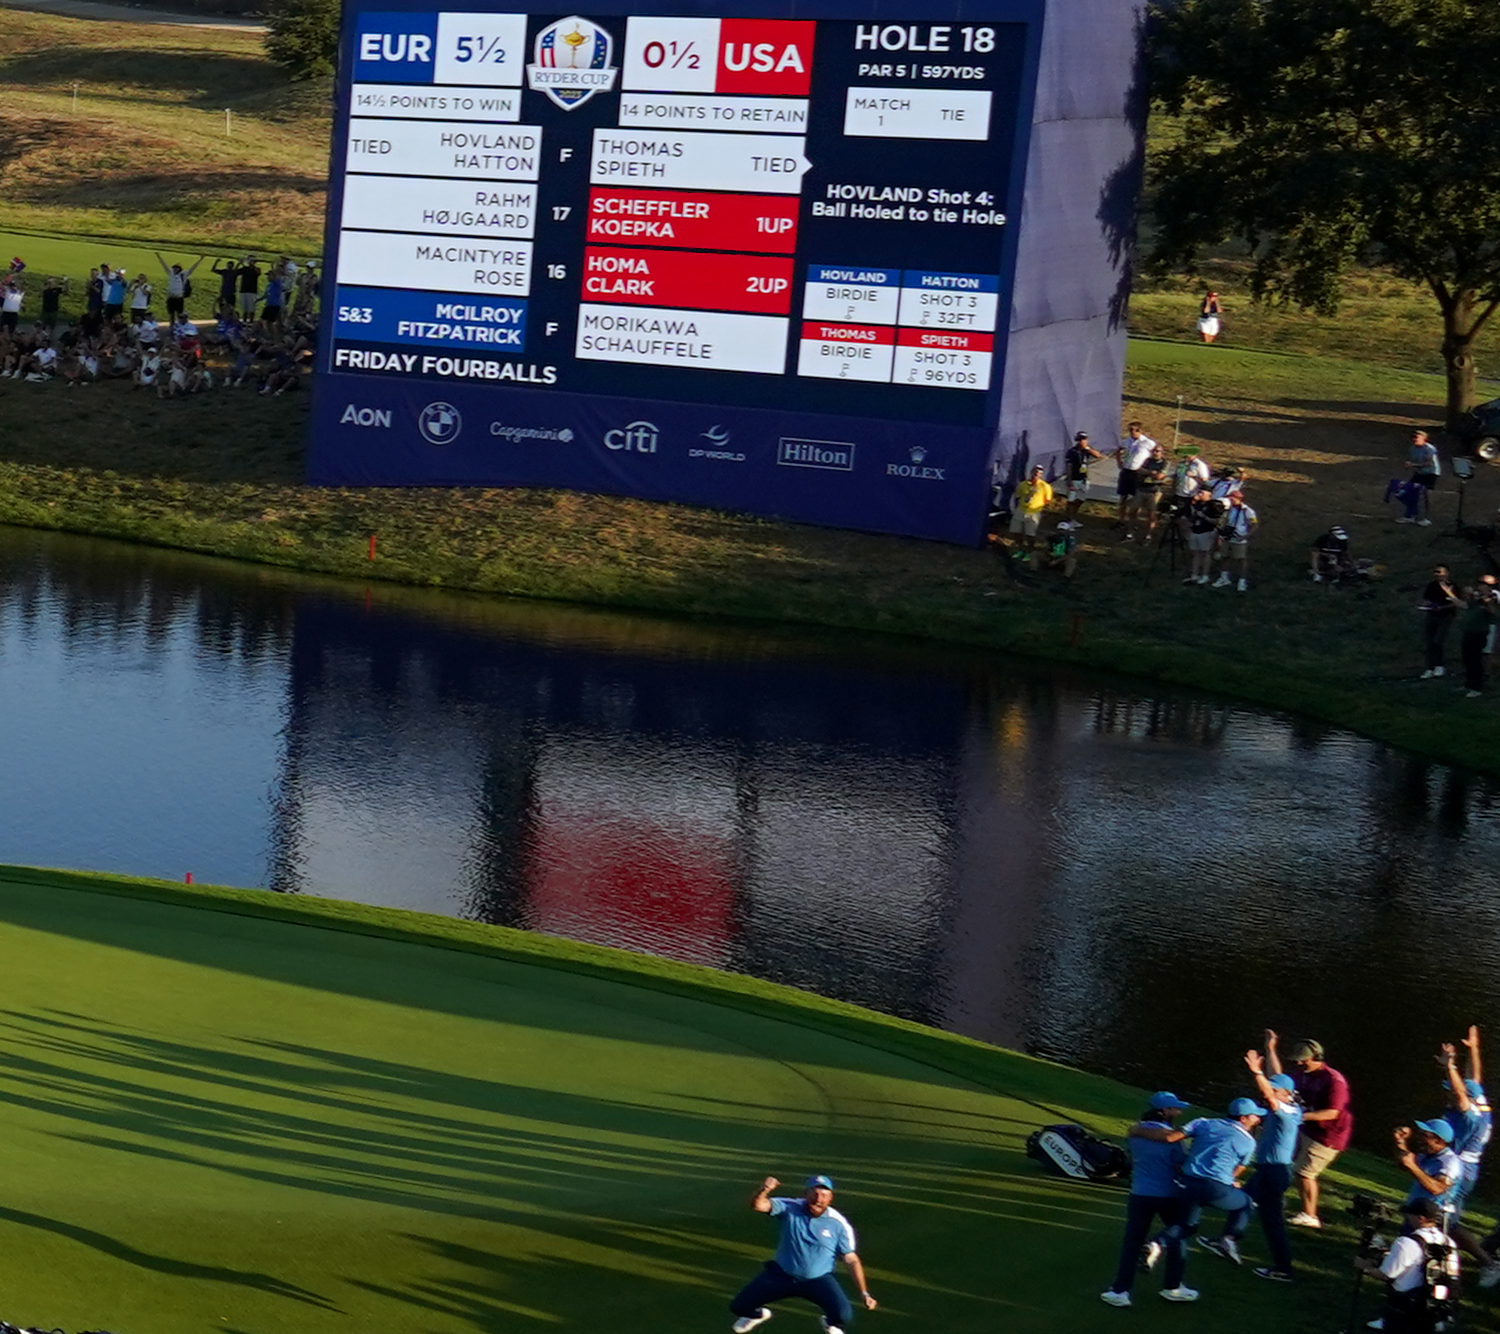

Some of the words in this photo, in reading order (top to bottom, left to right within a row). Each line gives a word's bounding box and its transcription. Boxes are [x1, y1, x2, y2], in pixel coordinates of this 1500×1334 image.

[855, 25, 951, 51] HOLE
[961, 27, 995, 53] 18
[360, 33, 431, 62] EUR
[724, 43, 805, 73] USA
[535, 72, 579, 83] RYDER
[581, 73, 609, 84] CUP
[858, 64, 892, 77] PAR
[896, 65, 906, 77] 5
[922, 66, 985, 79] 597YDS
[390, 95, 446, 109] POINTS
[453, 98, 473, 110] TO
[479, 99, 511, 111] WIN
[854, 98, 910, 110] MATCH
[622, 104, 638, 116] 14
[645, 105, 705, 118] POINTS
[713, 107, 735, 120] TO
[741, 108, 804, 122] RETAIN
[878, 116, 883, 126] 1
[941, 109, 965, 121] TIE
[352, 139, 392, 154] TIED
[441, 133, 535, 150] HOVLAND
[600, 139, 683, 157] THOMAS
[454, 154, 533, 170] HATTON
[560, 148, 573, 162] F
[597, 161, 665, 177] SPIETH
[751, 156, 796, 172] TIED
[475, 192, 531, 208] RAHM
[827, 184, 922, 202] HOVLAND
[927, 189, 971, 204] Shot
[975, 191, 994, 206] 4:
[552, 206, 571, 221] 17
[593, 198, 710, 218] SCHEFFLER
[812, 202, 845, 217] Ball
[851, 203, 904, 220] Holed
[909, 207, 928, 221] to
[933, 208, 957, 223] tie
[963, 209, 1006, 225] Hole
[423, 210, 529, 229] HØJGAARD
[756, 217, 793, 233] 1UP
[591, 219, 674, 238] KOEPKA
[416, 246, 527, 265] MACINTYRE
[547, 265, 566, 279] 16
[588, 256, 650, 274] HOMA
[474, 270, 524, 286] ROSE
[820, 270, 886, 283] HOVLAND
[922, 276, 979, 288] HATTON
[586, 277, 655, 296] CLARK
[746, 277, 788, 294] 2UP
[826, 288, 878, 301] BIRDIE
[920, 293, 963, 306] SHOT
[968, 297, 977, 308] 3
[338, 306, 372, 323] 5&3
[436, 304, 523, 323] MCILROY
[937, 312, 976, 325] 32FT
[398, 321, 521, 345] FITZPATRICK
[546, 323, 558, 336] F
[584, 315, 698, 336] MORIKAWA
[820, 327, 876, 341] THOMAS
[921, 334, 968, 347] SPIETH
[582, 336, 712, 359] SCHAUFFELE
[821, 345, 872, 359] BIRDIE
[335, 349, 417, 372] FRIDAY
[423, 356, 557, 384] FOURBALLS
[914, 352, 957, 364] SHOT
[963, 355, 971, 366] 3
[925, 370, 977, 384] 96YDS
[490, 421, 558, 442] Capgemini
[604, 423, 658, 453] citi
[784, 443, 847, 464] Hilton
[887, 464, 945, 480] ROLEX
[1043, 1135, 1082, 1174] EUROPE
